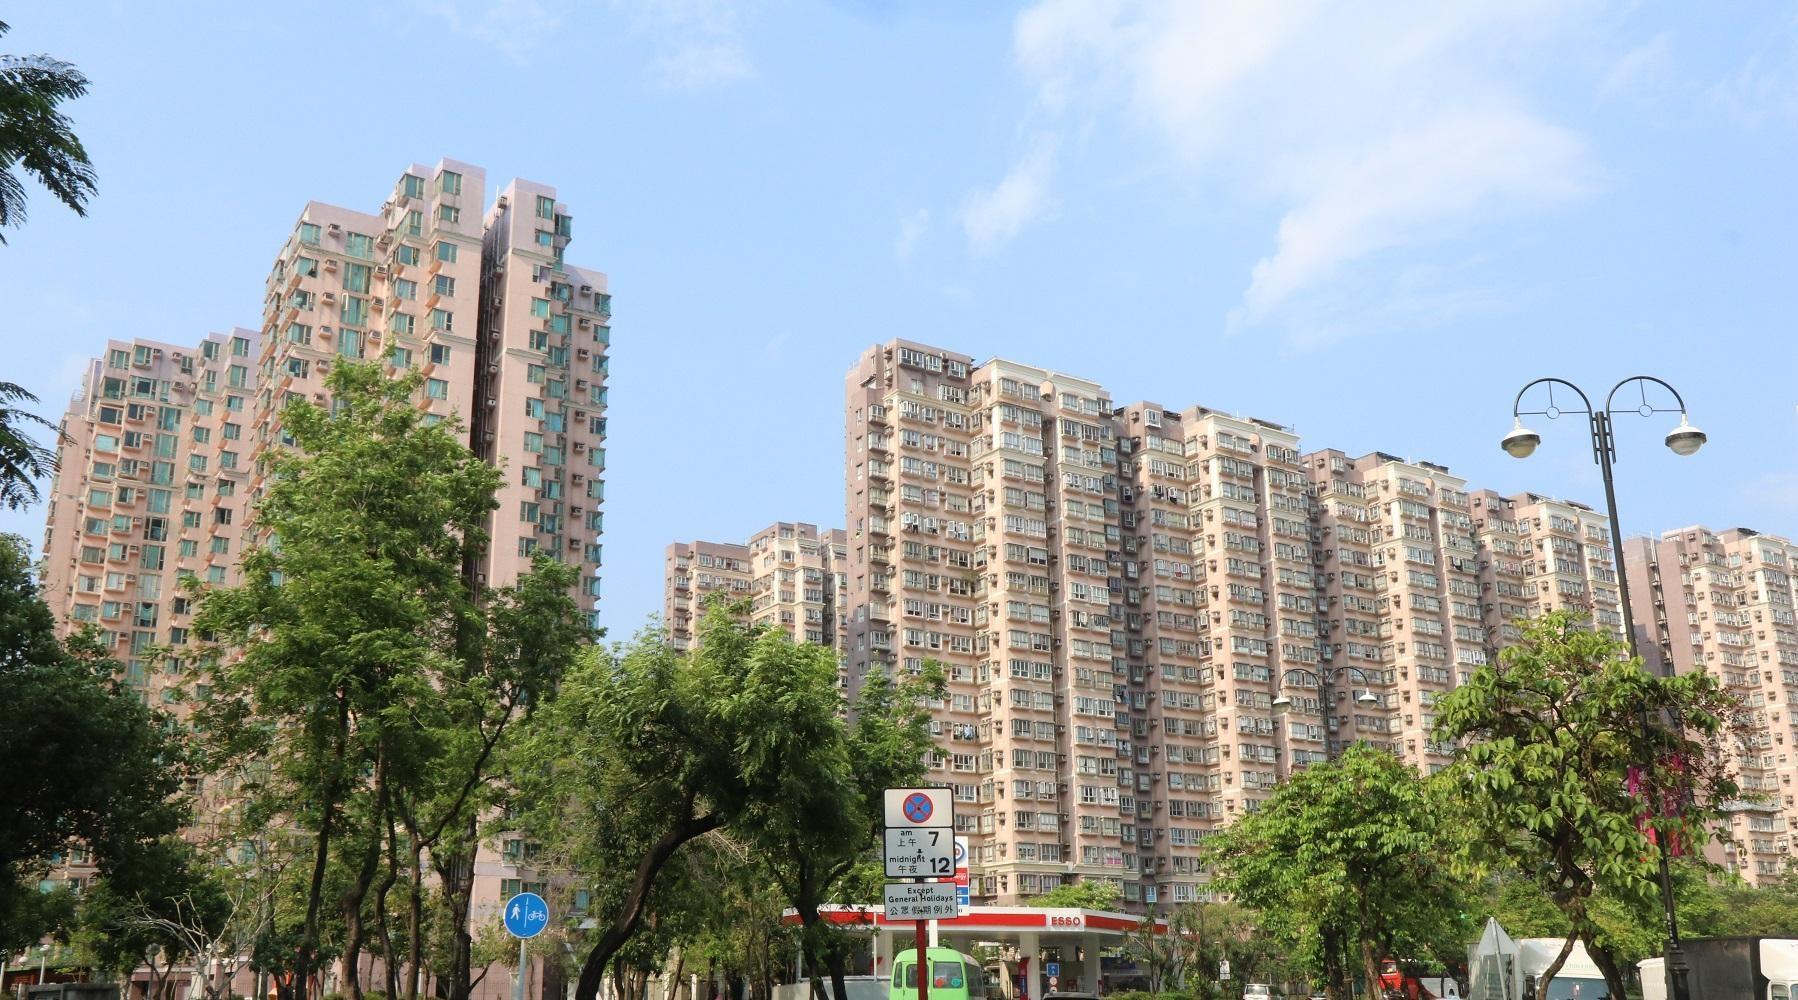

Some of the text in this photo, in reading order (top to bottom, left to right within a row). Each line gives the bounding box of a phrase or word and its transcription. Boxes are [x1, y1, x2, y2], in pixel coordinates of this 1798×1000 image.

[897, 837, 917, 847] 上午
[928, 831, 939, 847] 7
[889, 856, 925, 864] midnight
[898, 865, 918, 874] 午夜
[930, 857, 950, 873] 12
[907, 887, 934, 895] Except
[888, 895, 918, 903] General
[920, 895, 954, 903] Holidays
[1051, 917, 1080, 926] ESSO
